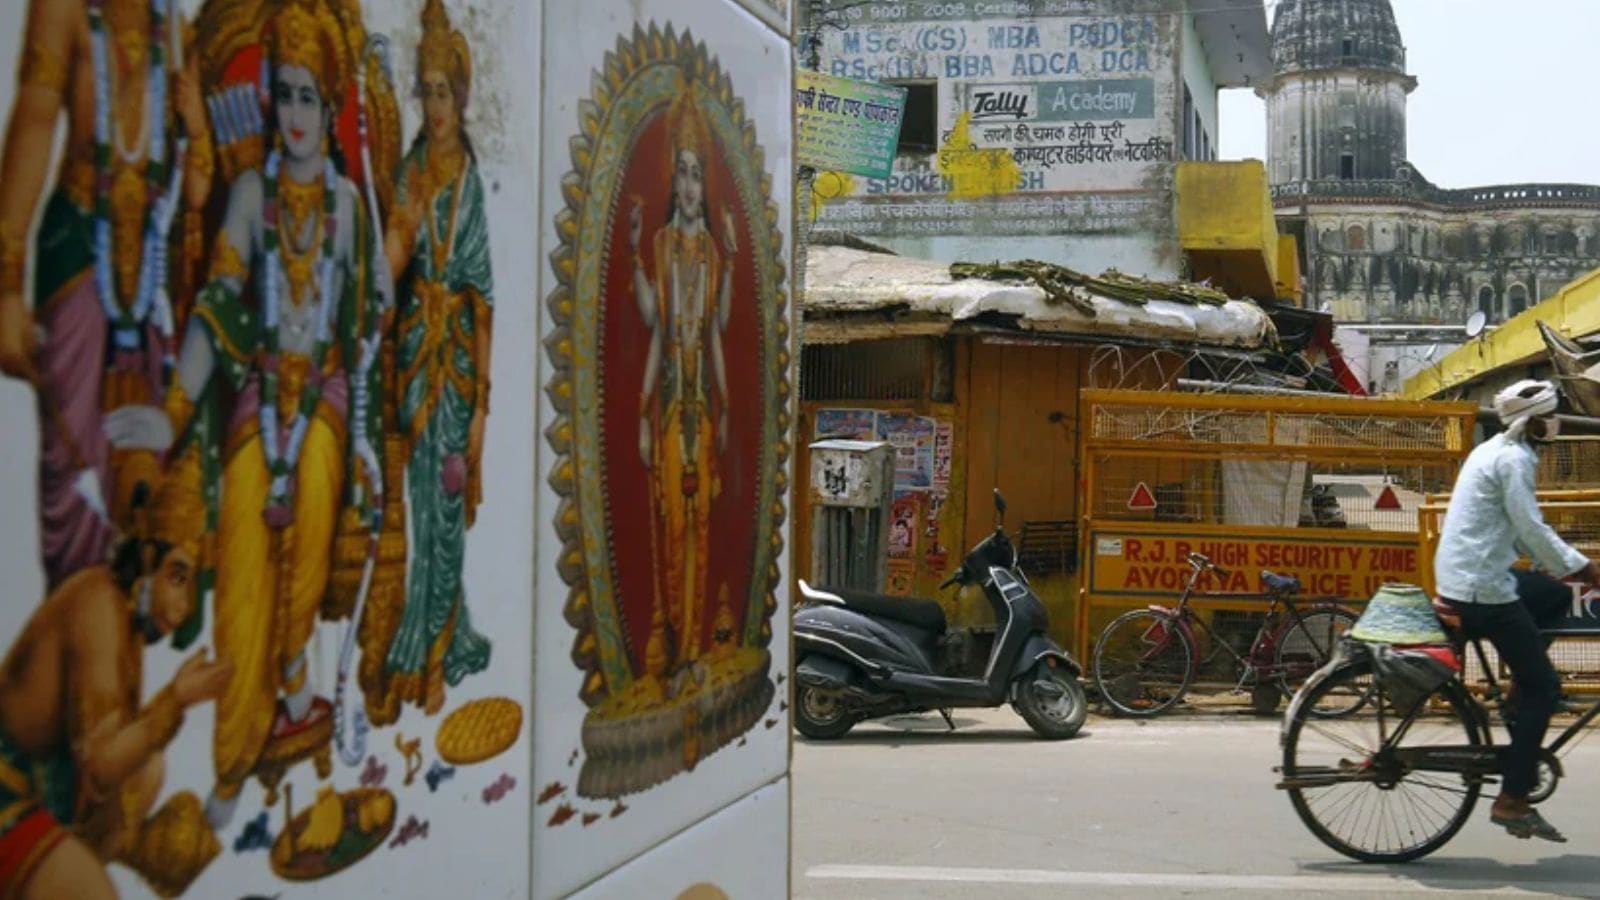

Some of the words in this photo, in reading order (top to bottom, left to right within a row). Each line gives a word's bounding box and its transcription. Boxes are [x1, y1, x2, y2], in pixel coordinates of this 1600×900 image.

[915, 27, 967, 52] (CS)
[988, 25, 1041, 49] MBA
[944, 55, 995, 78] BBA
[1012, 52, 1080, 76] ADCA
[1101, 49, 1151, 73] DCA
[972, 91, 1028, 119] Tally
[1051, 84, 1136, 114] Academy
[1099, 120, 1126, 142] पूरी
[1200, 542, 1249, 567] HIGH
[1255, 543, 1362, 571] SECURITY
[1369, 547, 1417, 572] ZONE
